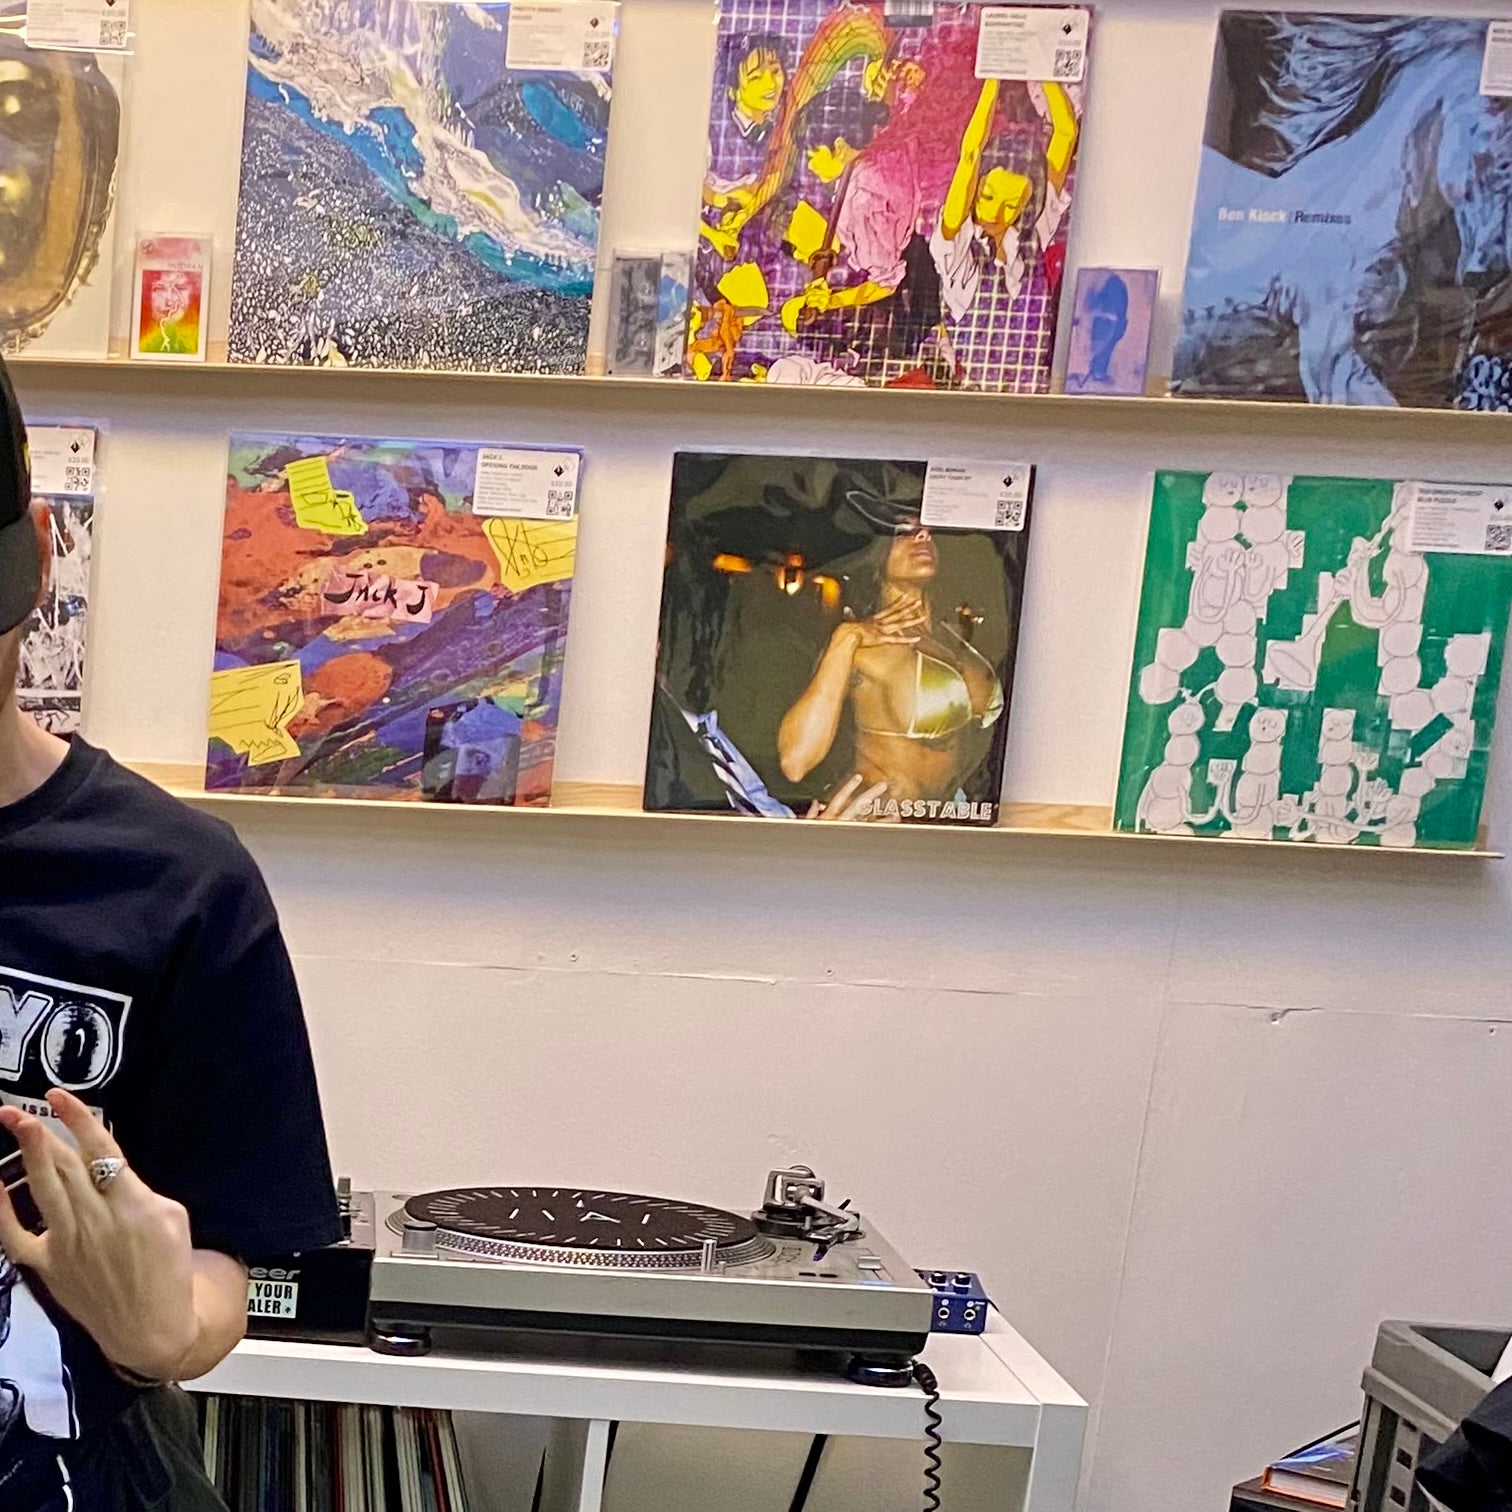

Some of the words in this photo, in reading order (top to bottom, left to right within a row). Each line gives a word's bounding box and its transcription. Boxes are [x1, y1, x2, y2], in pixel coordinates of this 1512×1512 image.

[1294, 210, 1351, 225] Remixes
[324, 573, 397, 609] Jack
[406, 585, 428, 615] J
[855, 798, 992, 820] GLASSTABLE
[249, 1267, 301, 1280] eer
[255, 1283, 293, 1300] YOUR
[247, 1299, 282, 1315] ALER
